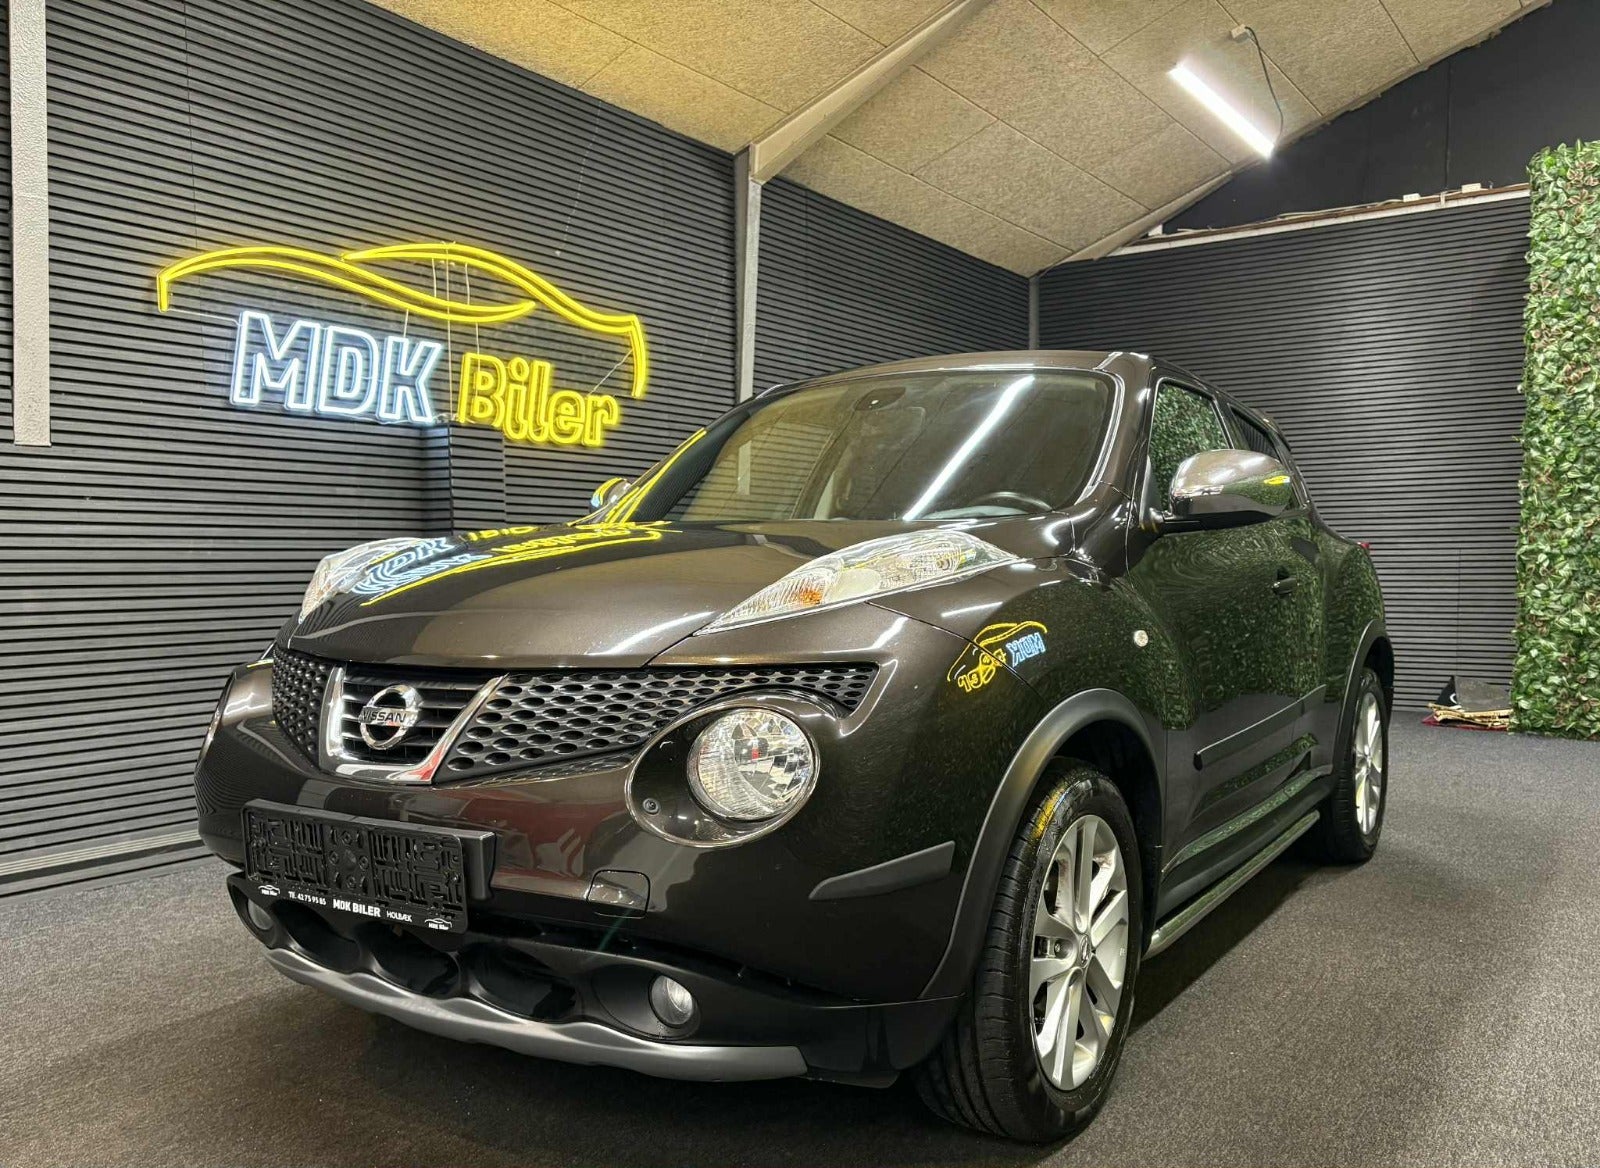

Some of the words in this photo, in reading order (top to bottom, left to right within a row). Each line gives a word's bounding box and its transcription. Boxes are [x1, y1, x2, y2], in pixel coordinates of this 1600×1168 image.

[230, 310, 443, 423] MDK
[457, 352, 620, 447] Biler
[362, 710, 407, 723] NISSAN
[333, 899, 351, 912] MDK
[352, 902, 381, 918] BILER
